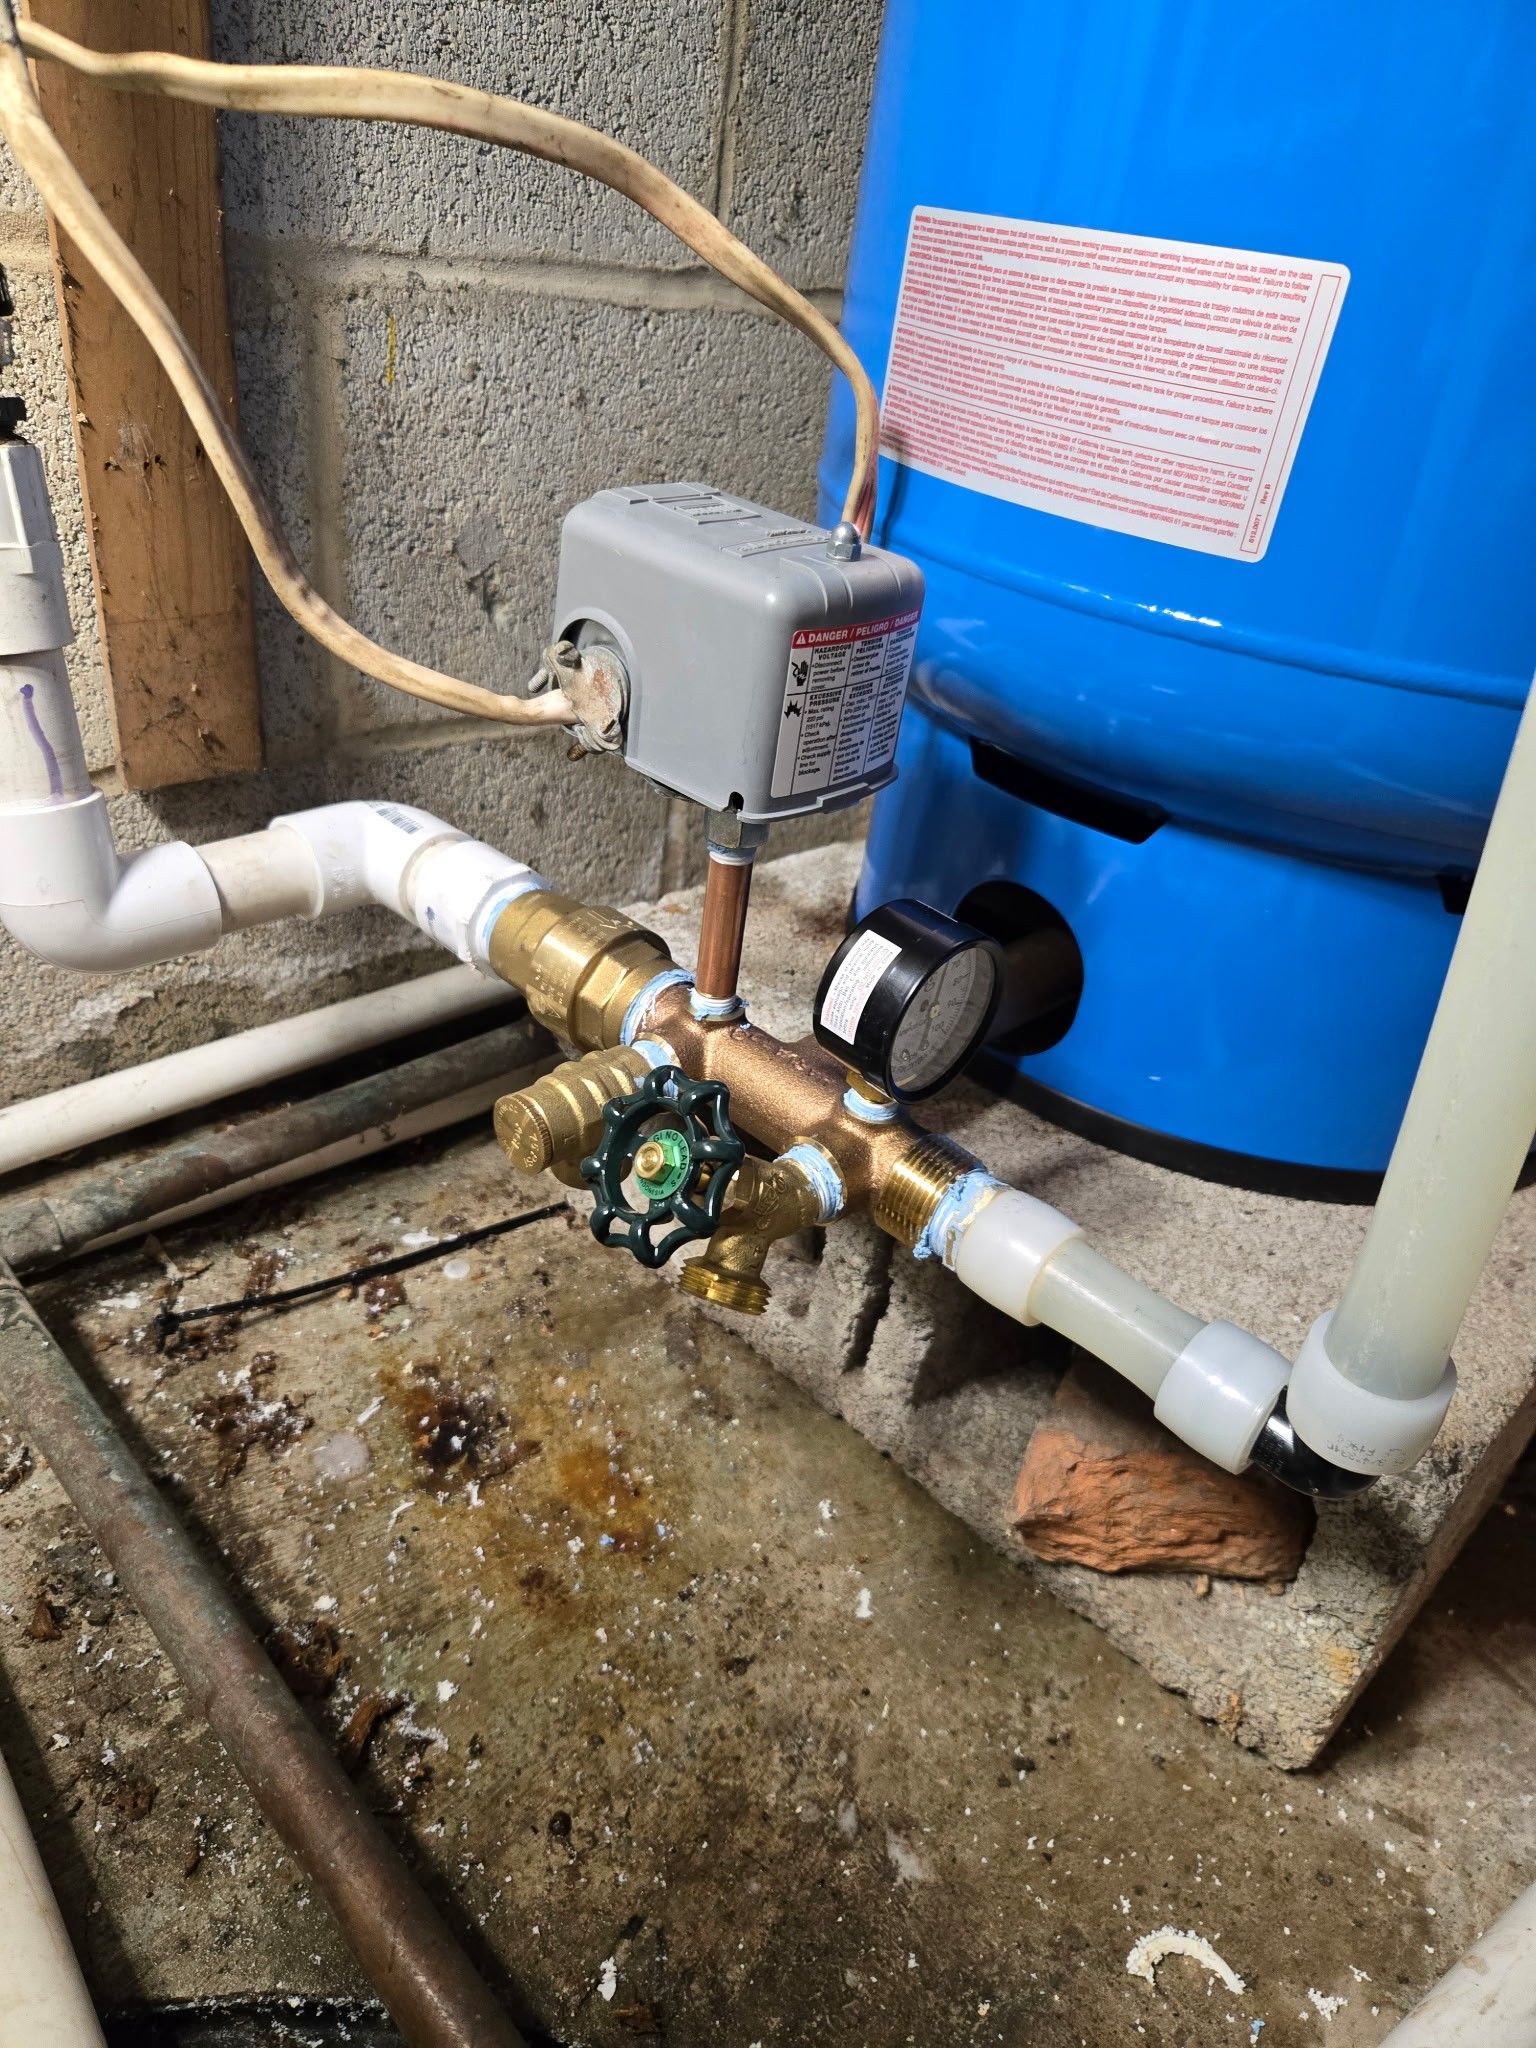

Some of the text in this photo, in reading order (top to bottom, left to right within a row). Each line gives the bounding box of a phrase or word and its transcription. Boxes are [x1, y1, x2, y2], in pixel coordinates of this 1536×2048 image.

[808, 630, 847, 642] DANGER
[856, 623, 889, 636] PELIGRO
[895, 614, 918, 627] DANGER
[815, 644, 851, 654] HAZARDOUS
[819, 652, 846, 660] VOLTAGE
[814, 660, 842, 669] Disconnect
[830, 666, 845, 674] before
[810, 690, 842, 700] EXCESSIVE
[810, 698, 840, 706] PRESSURE
[803, 737, 825, 746] operation
[801, 753, 818, 761] Check
[666, 1131, 678, 1141] NO
[678, 1140, 687, 1170] LEAD
[640, 1178, 664, 1195] NDONESIA
